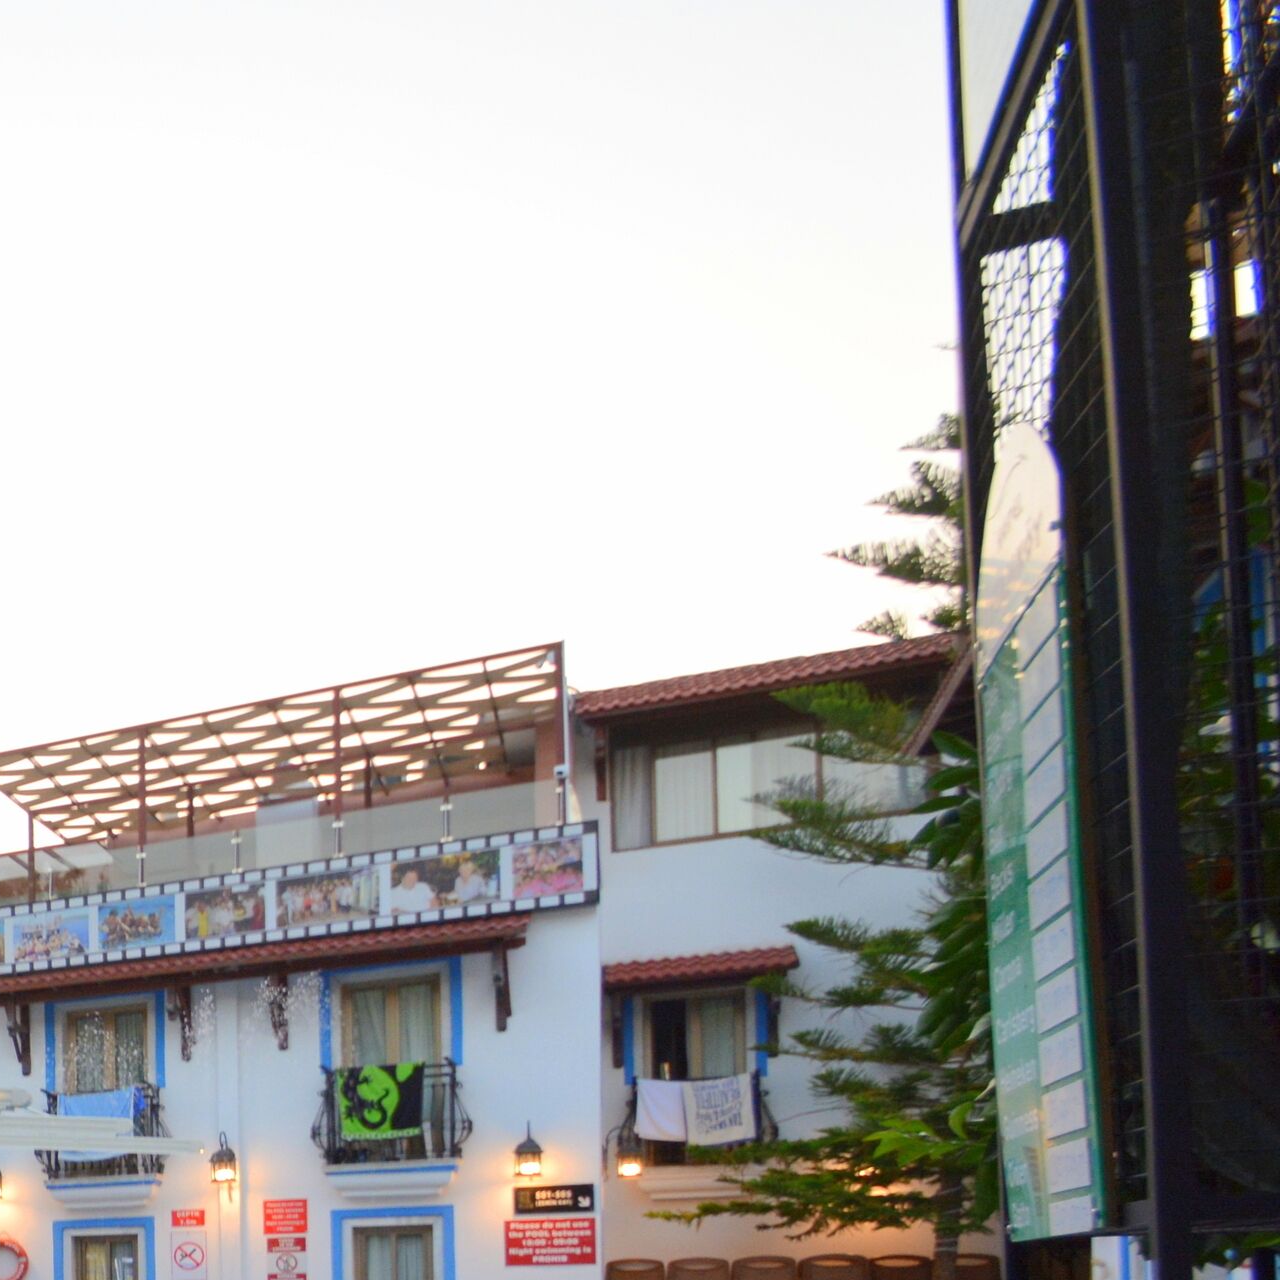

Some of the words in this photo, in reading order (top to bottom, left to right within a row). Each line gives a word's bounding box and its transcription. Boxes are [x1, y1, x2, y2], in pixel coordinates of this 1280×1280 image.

[510, 1222, 540, 1230] Please
[555, 1221, 571, 1229] not
[509, 1231, 523, 1239] the
[525, 1230, 550, 1238] POOL
[551, 1229, 591, 1237] between
[509, 1247, 533, 1256] Night
[583, 1245, 591, 1253] is
